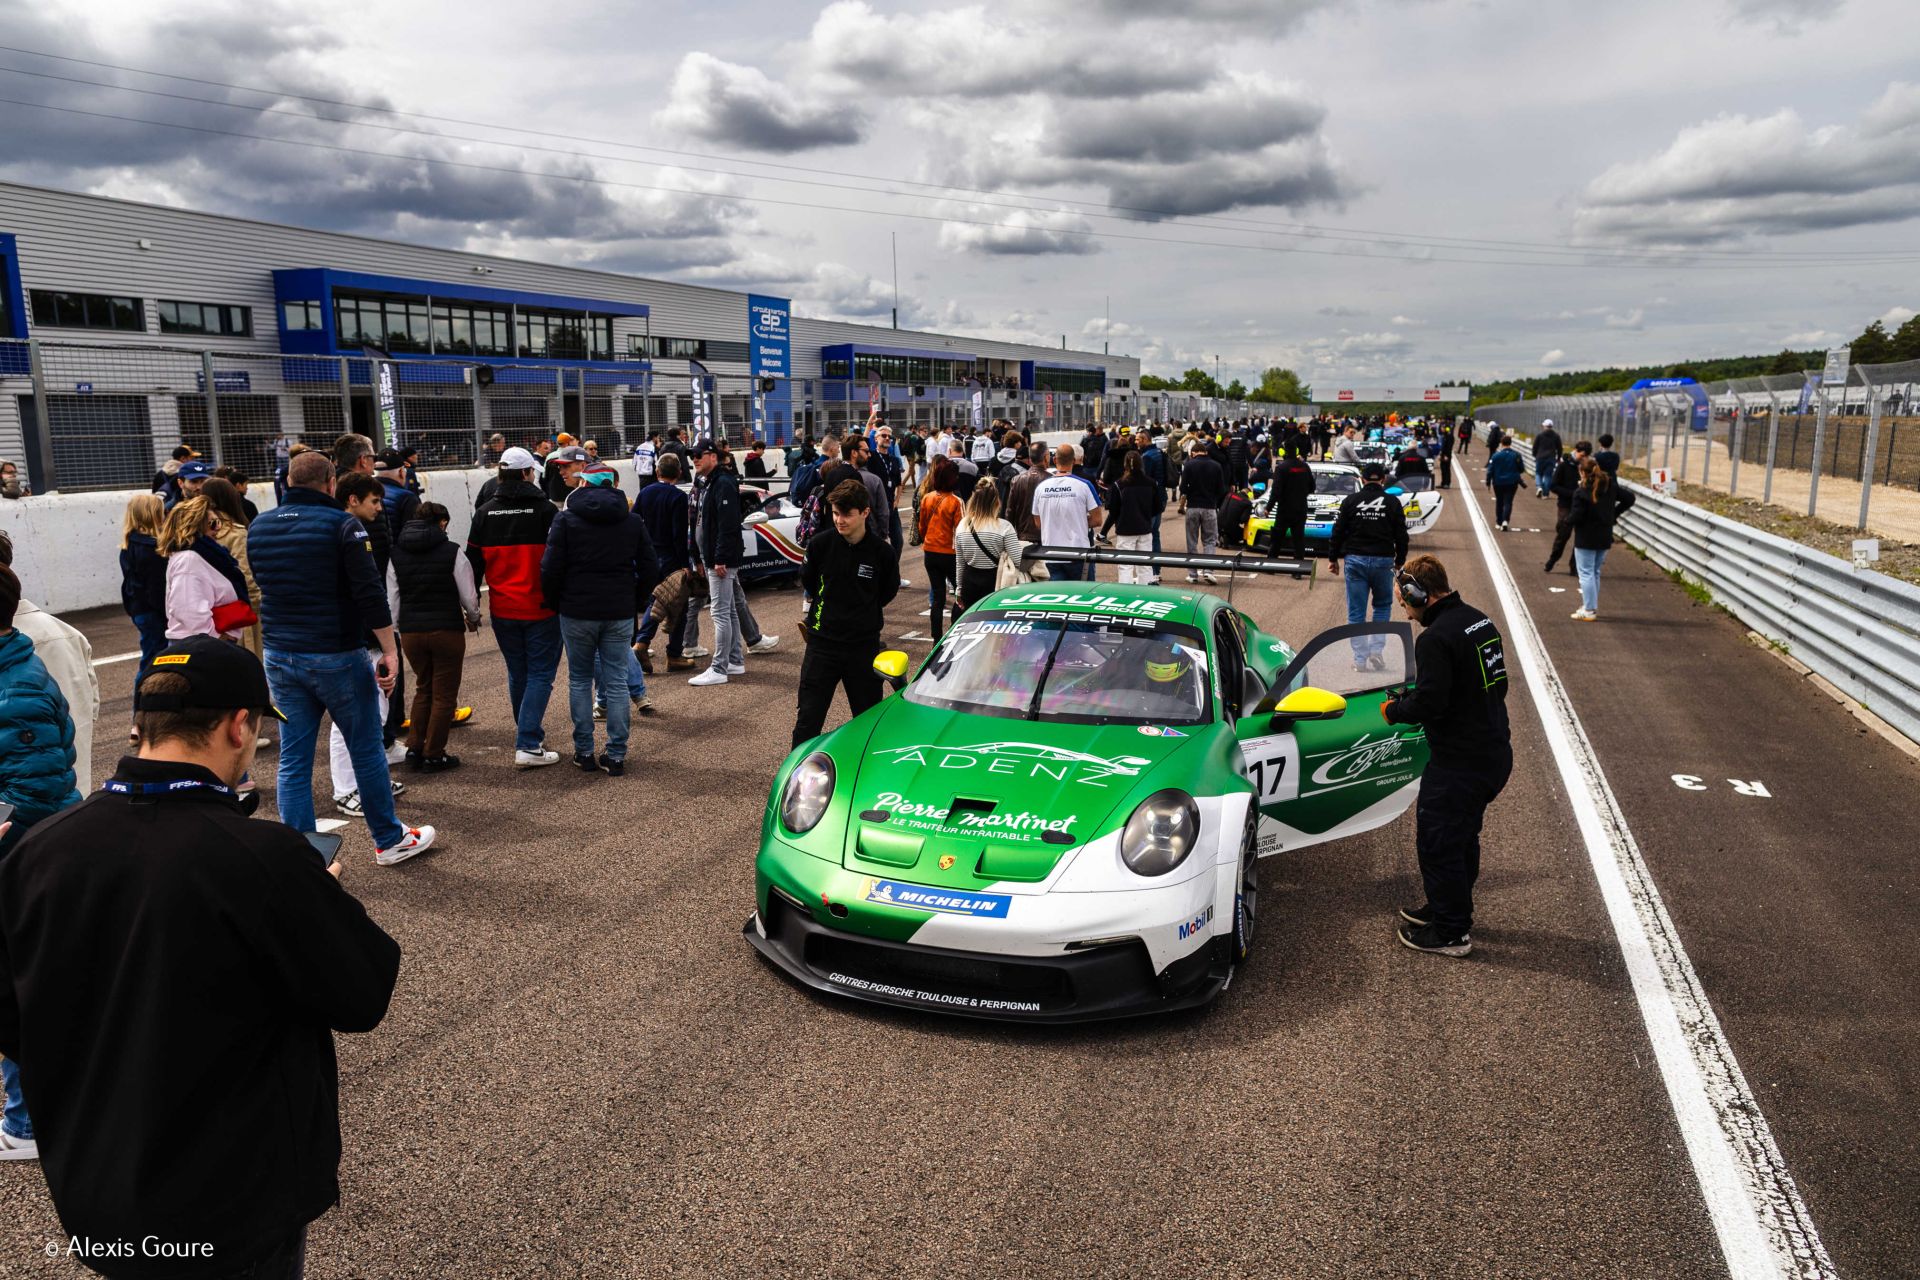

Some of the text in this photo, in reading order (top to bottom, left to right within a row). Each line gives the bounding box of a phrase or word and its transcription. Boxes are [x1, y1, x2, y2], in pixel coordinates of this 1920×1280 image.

[761, 358, 782, 367] Welcome
[488, 508, 534, 516] PORSCHE
[751, 560, 775, 569] Porsche
[999, 593, 1178, 613] JOULIÉ
[1093, 605, 1166, 618] GROUPE
[969, 620, 1034, 635] Joulié
[1003, 610, 1156, 629] PORSCHE
[938, 633, 988, 663] 17
[892, 750, 1114, 788] ADENZ
[1249, 756, 1286, 797] 17
[874, 792, 950, 820] Pierre
[893, 817, 1031, 842] LE TRAITEUR INTRAITABLE
[898, 891, 998, 911] MICHELIN
[1178, 911, 1206, 940] Mobil
[829, 972, 1040, 1011] CENTRES PORSCHE TOULOUSE & PERPIGNAN
